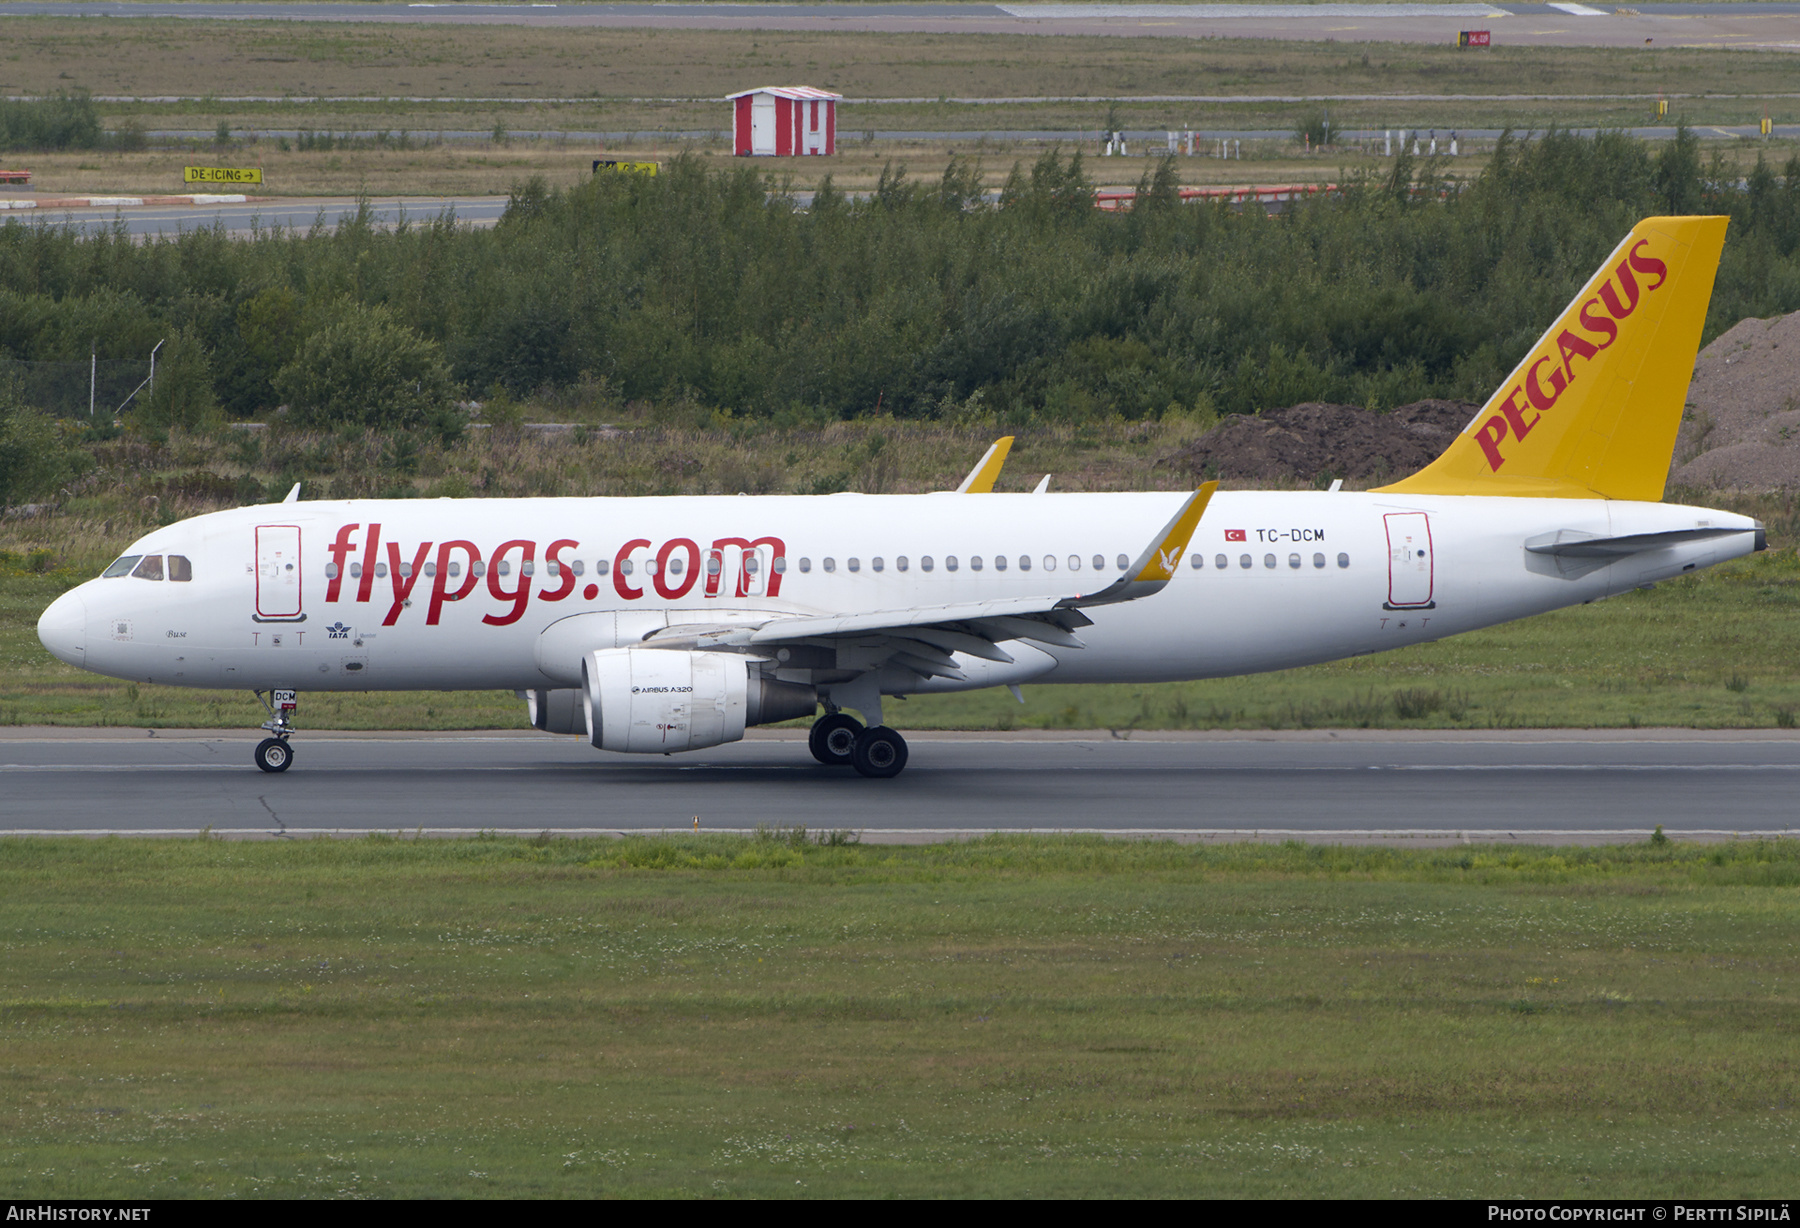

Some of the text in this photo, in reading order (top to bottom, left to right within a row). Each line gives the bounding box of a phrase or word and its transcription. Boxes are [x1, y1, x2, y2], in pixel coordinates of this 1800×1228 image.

[191, 168, 241, 180] DE-ICING
[1473, 238, 1667, 473] PEGASUS
[1256, 529, 1325, 542] TC-DCM
[324, 523, 786, 627] flypgs.com
[165, 630, 187, 638] Buse
[641, 686, 669, 694] AIRBUS
[275, 692, 296, 701] DCM
